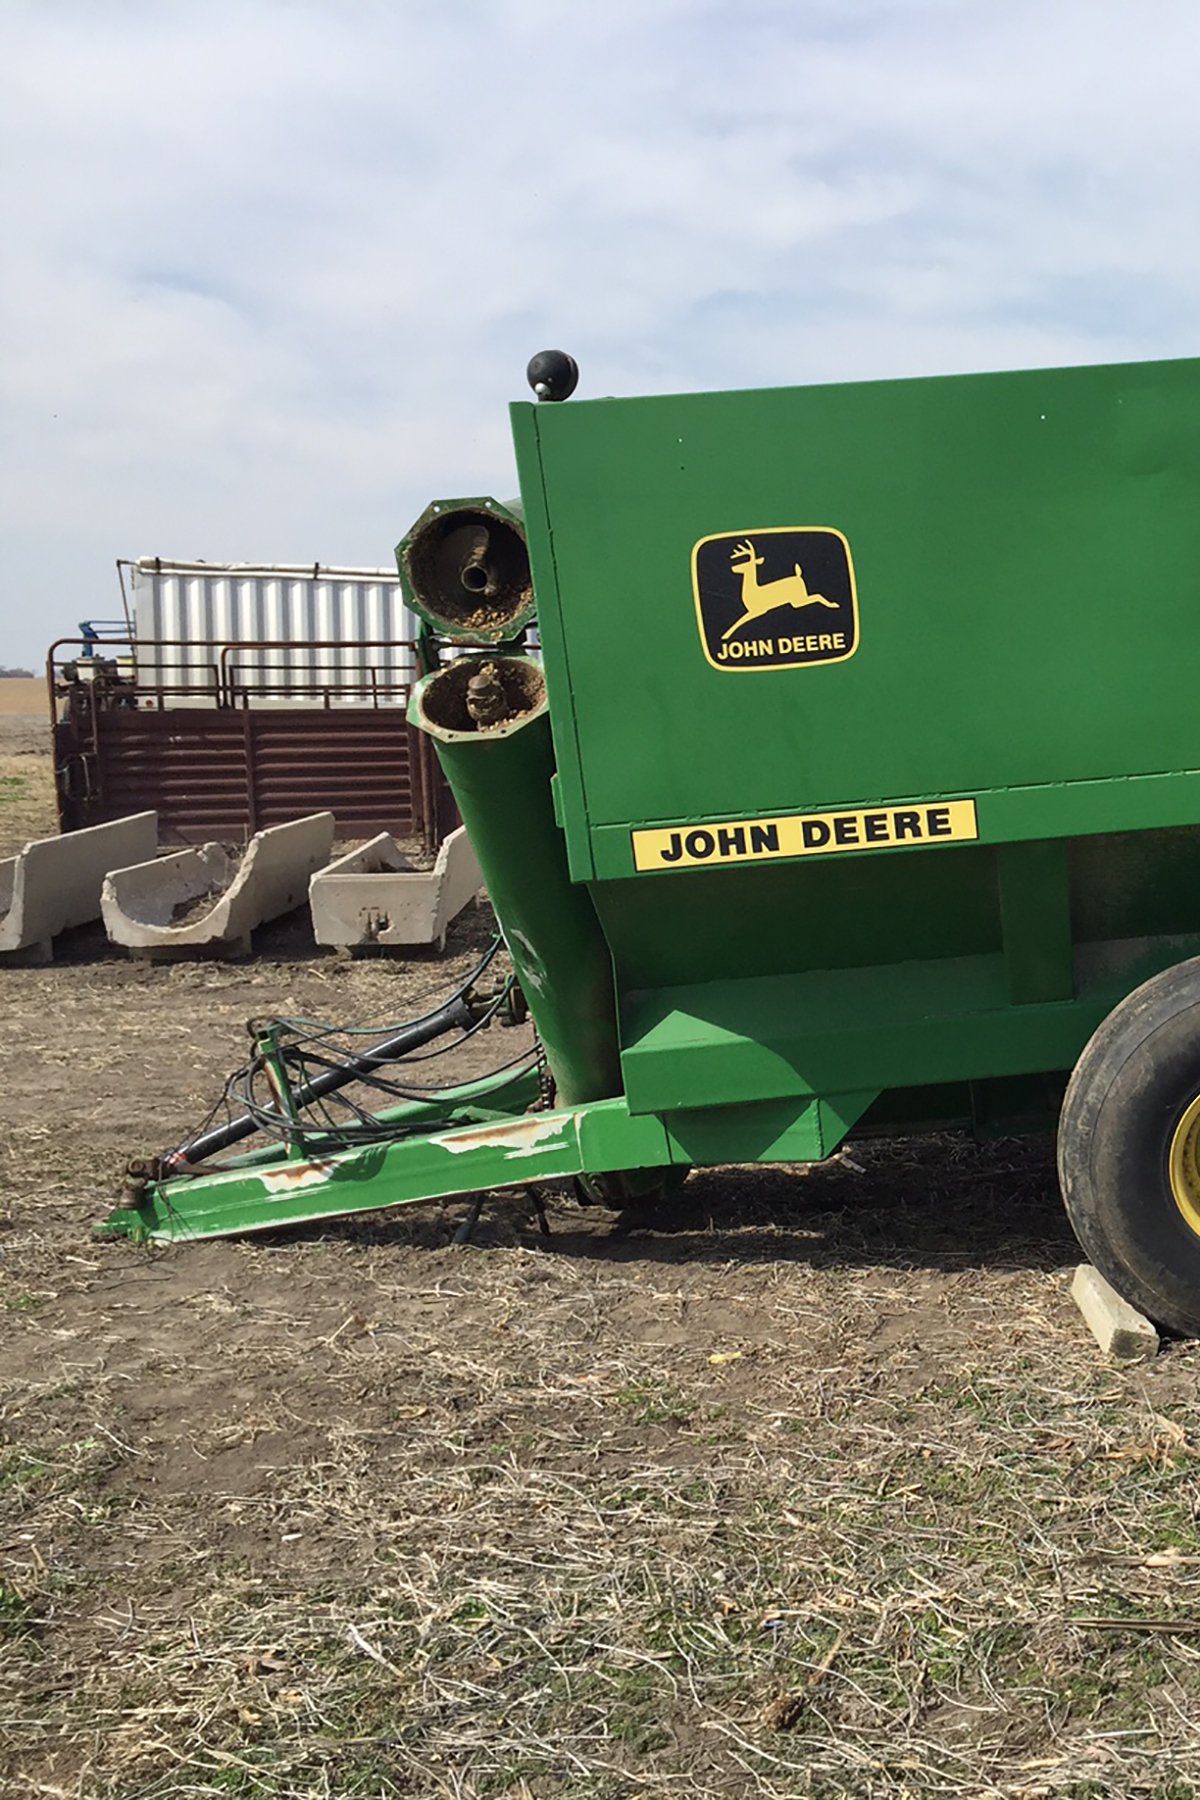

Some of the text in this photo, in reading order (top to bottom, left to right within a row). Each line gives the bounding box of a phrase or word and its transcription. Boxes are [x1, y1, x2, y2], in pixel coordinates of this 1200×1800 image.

[717, 633, 846, 660] JOHN DEERE
[661, 808, 952, 862] JOHN DEERE
